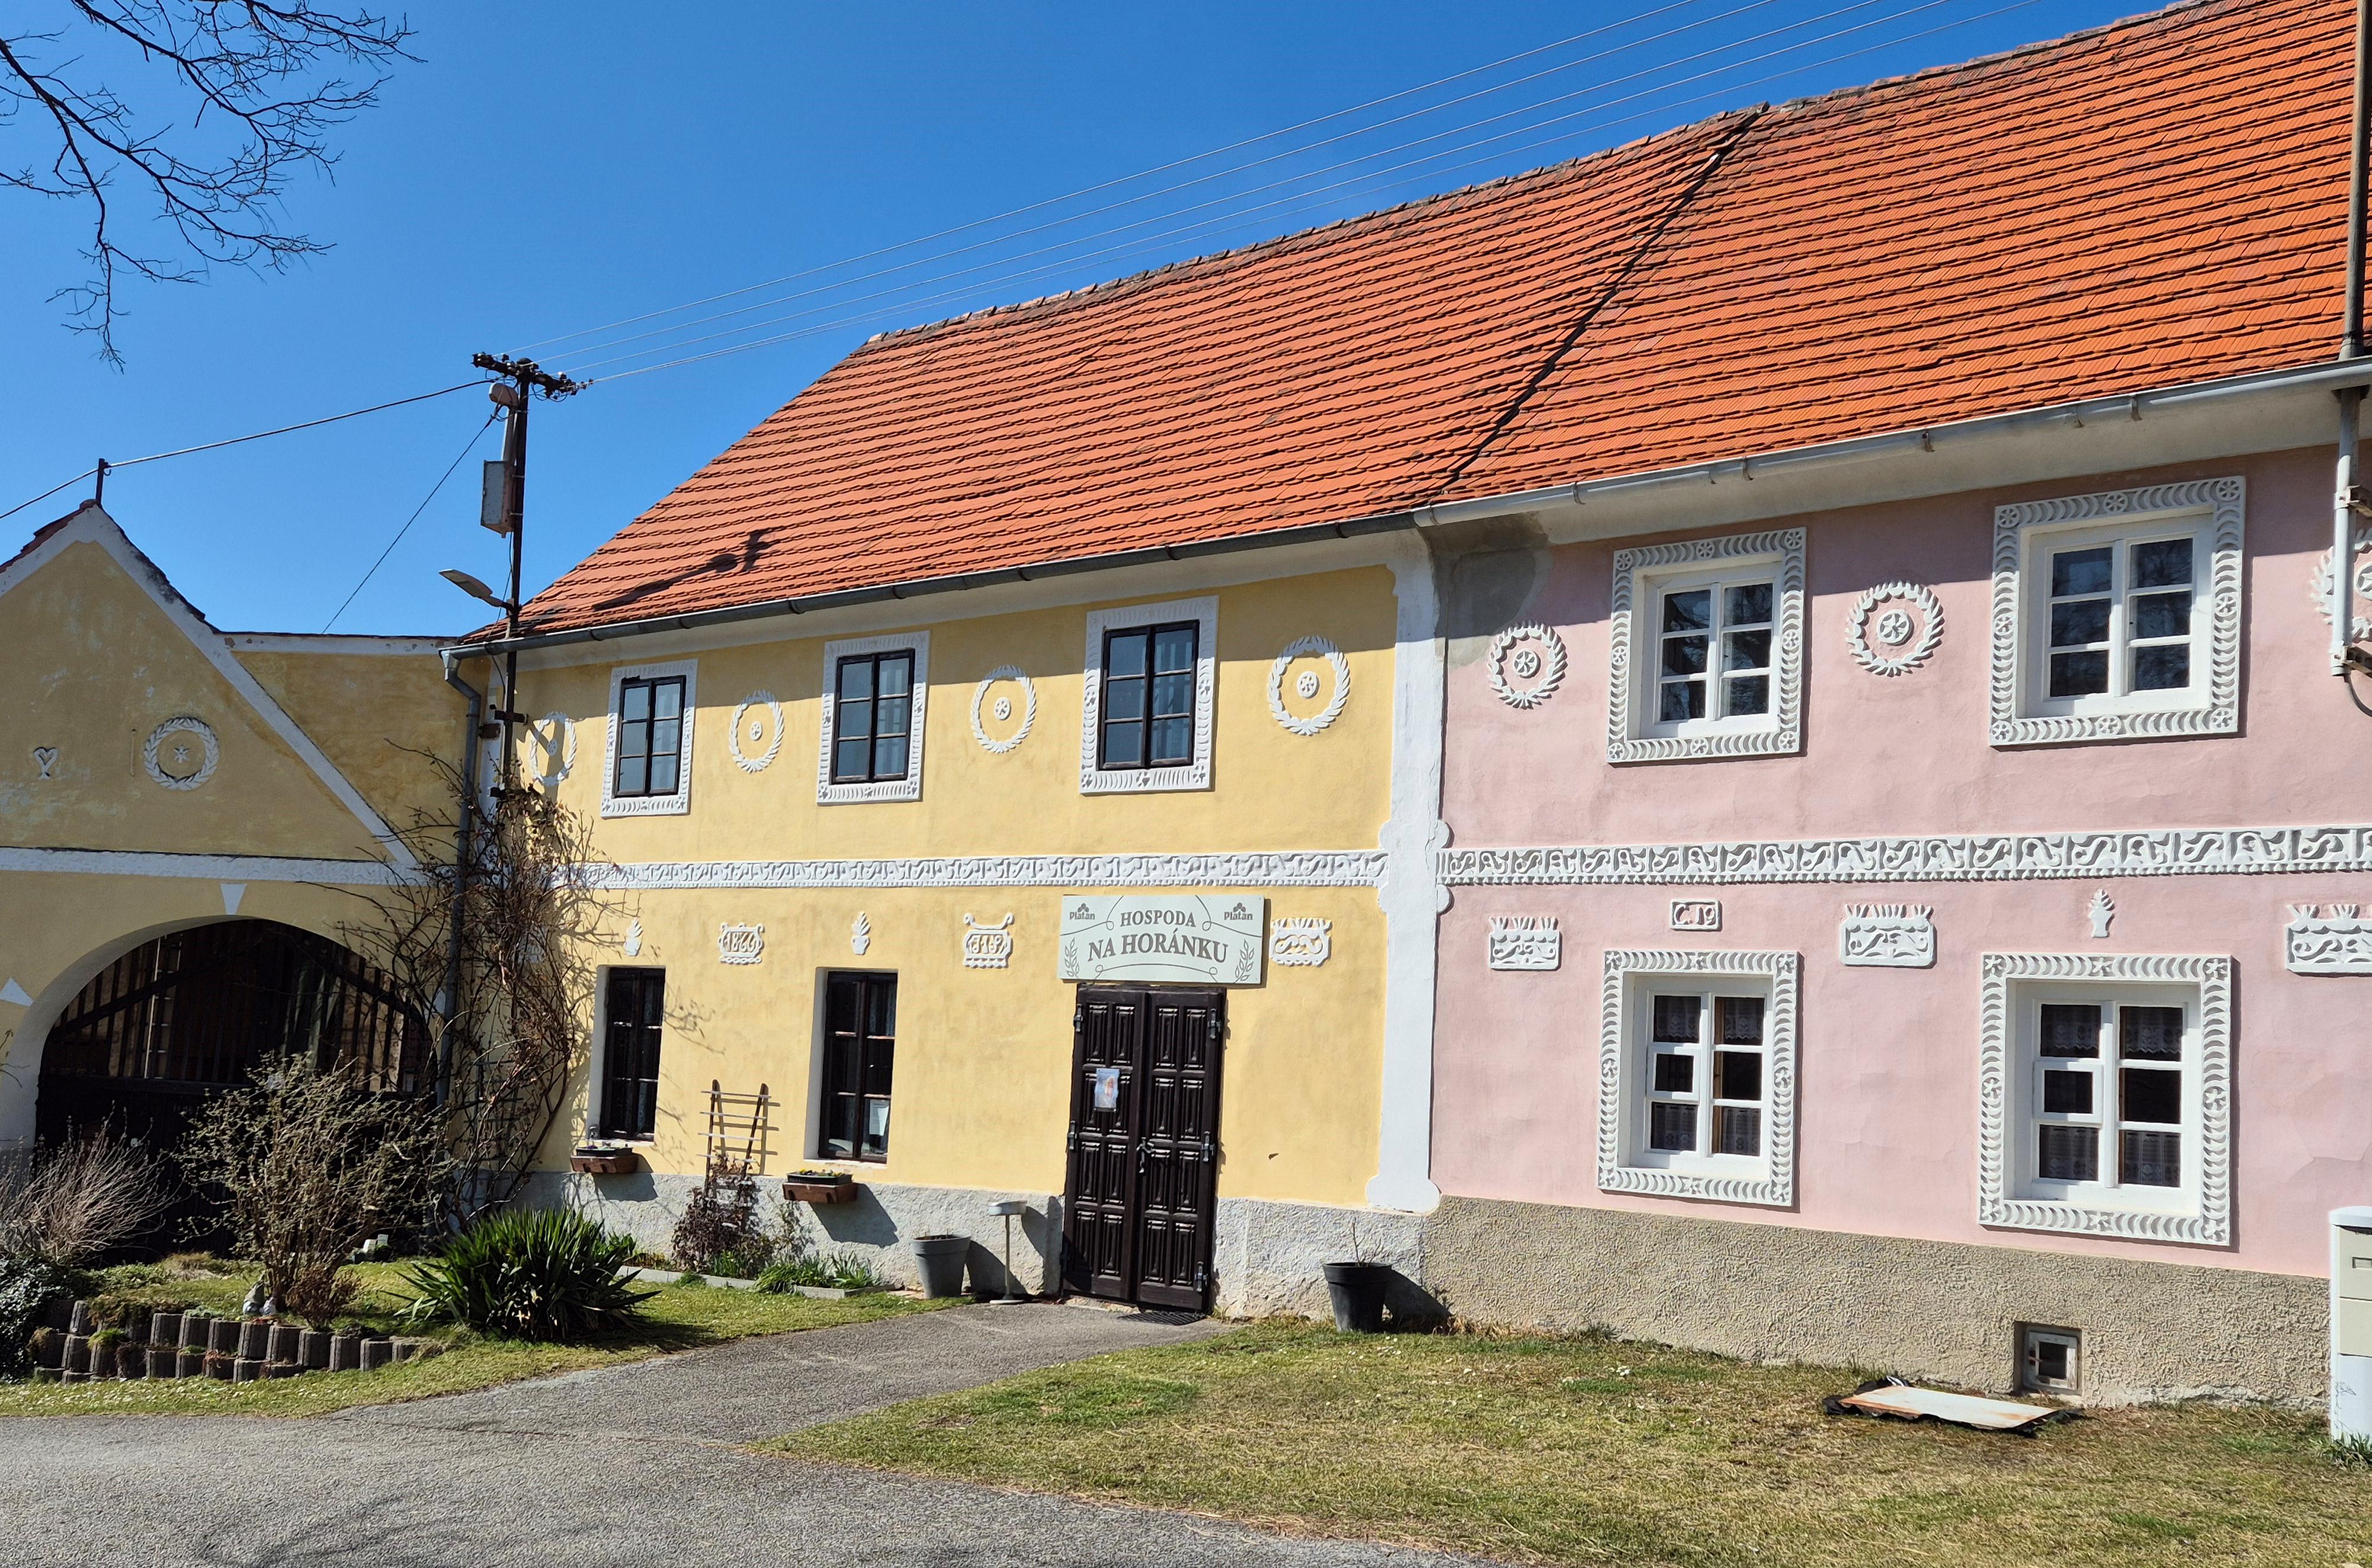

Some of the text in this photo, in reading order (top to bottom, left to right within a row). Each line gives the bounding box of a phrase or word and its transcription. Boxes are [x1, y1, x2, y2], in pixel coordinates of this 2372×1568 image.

[1069, 911, 1095, 920] Platan
[1120, 910, 1196, 927] HOSPODA
[1224, 911, 1253, 920] Platan
[1088, 928, 1229, 963] NA HORÁNKU
